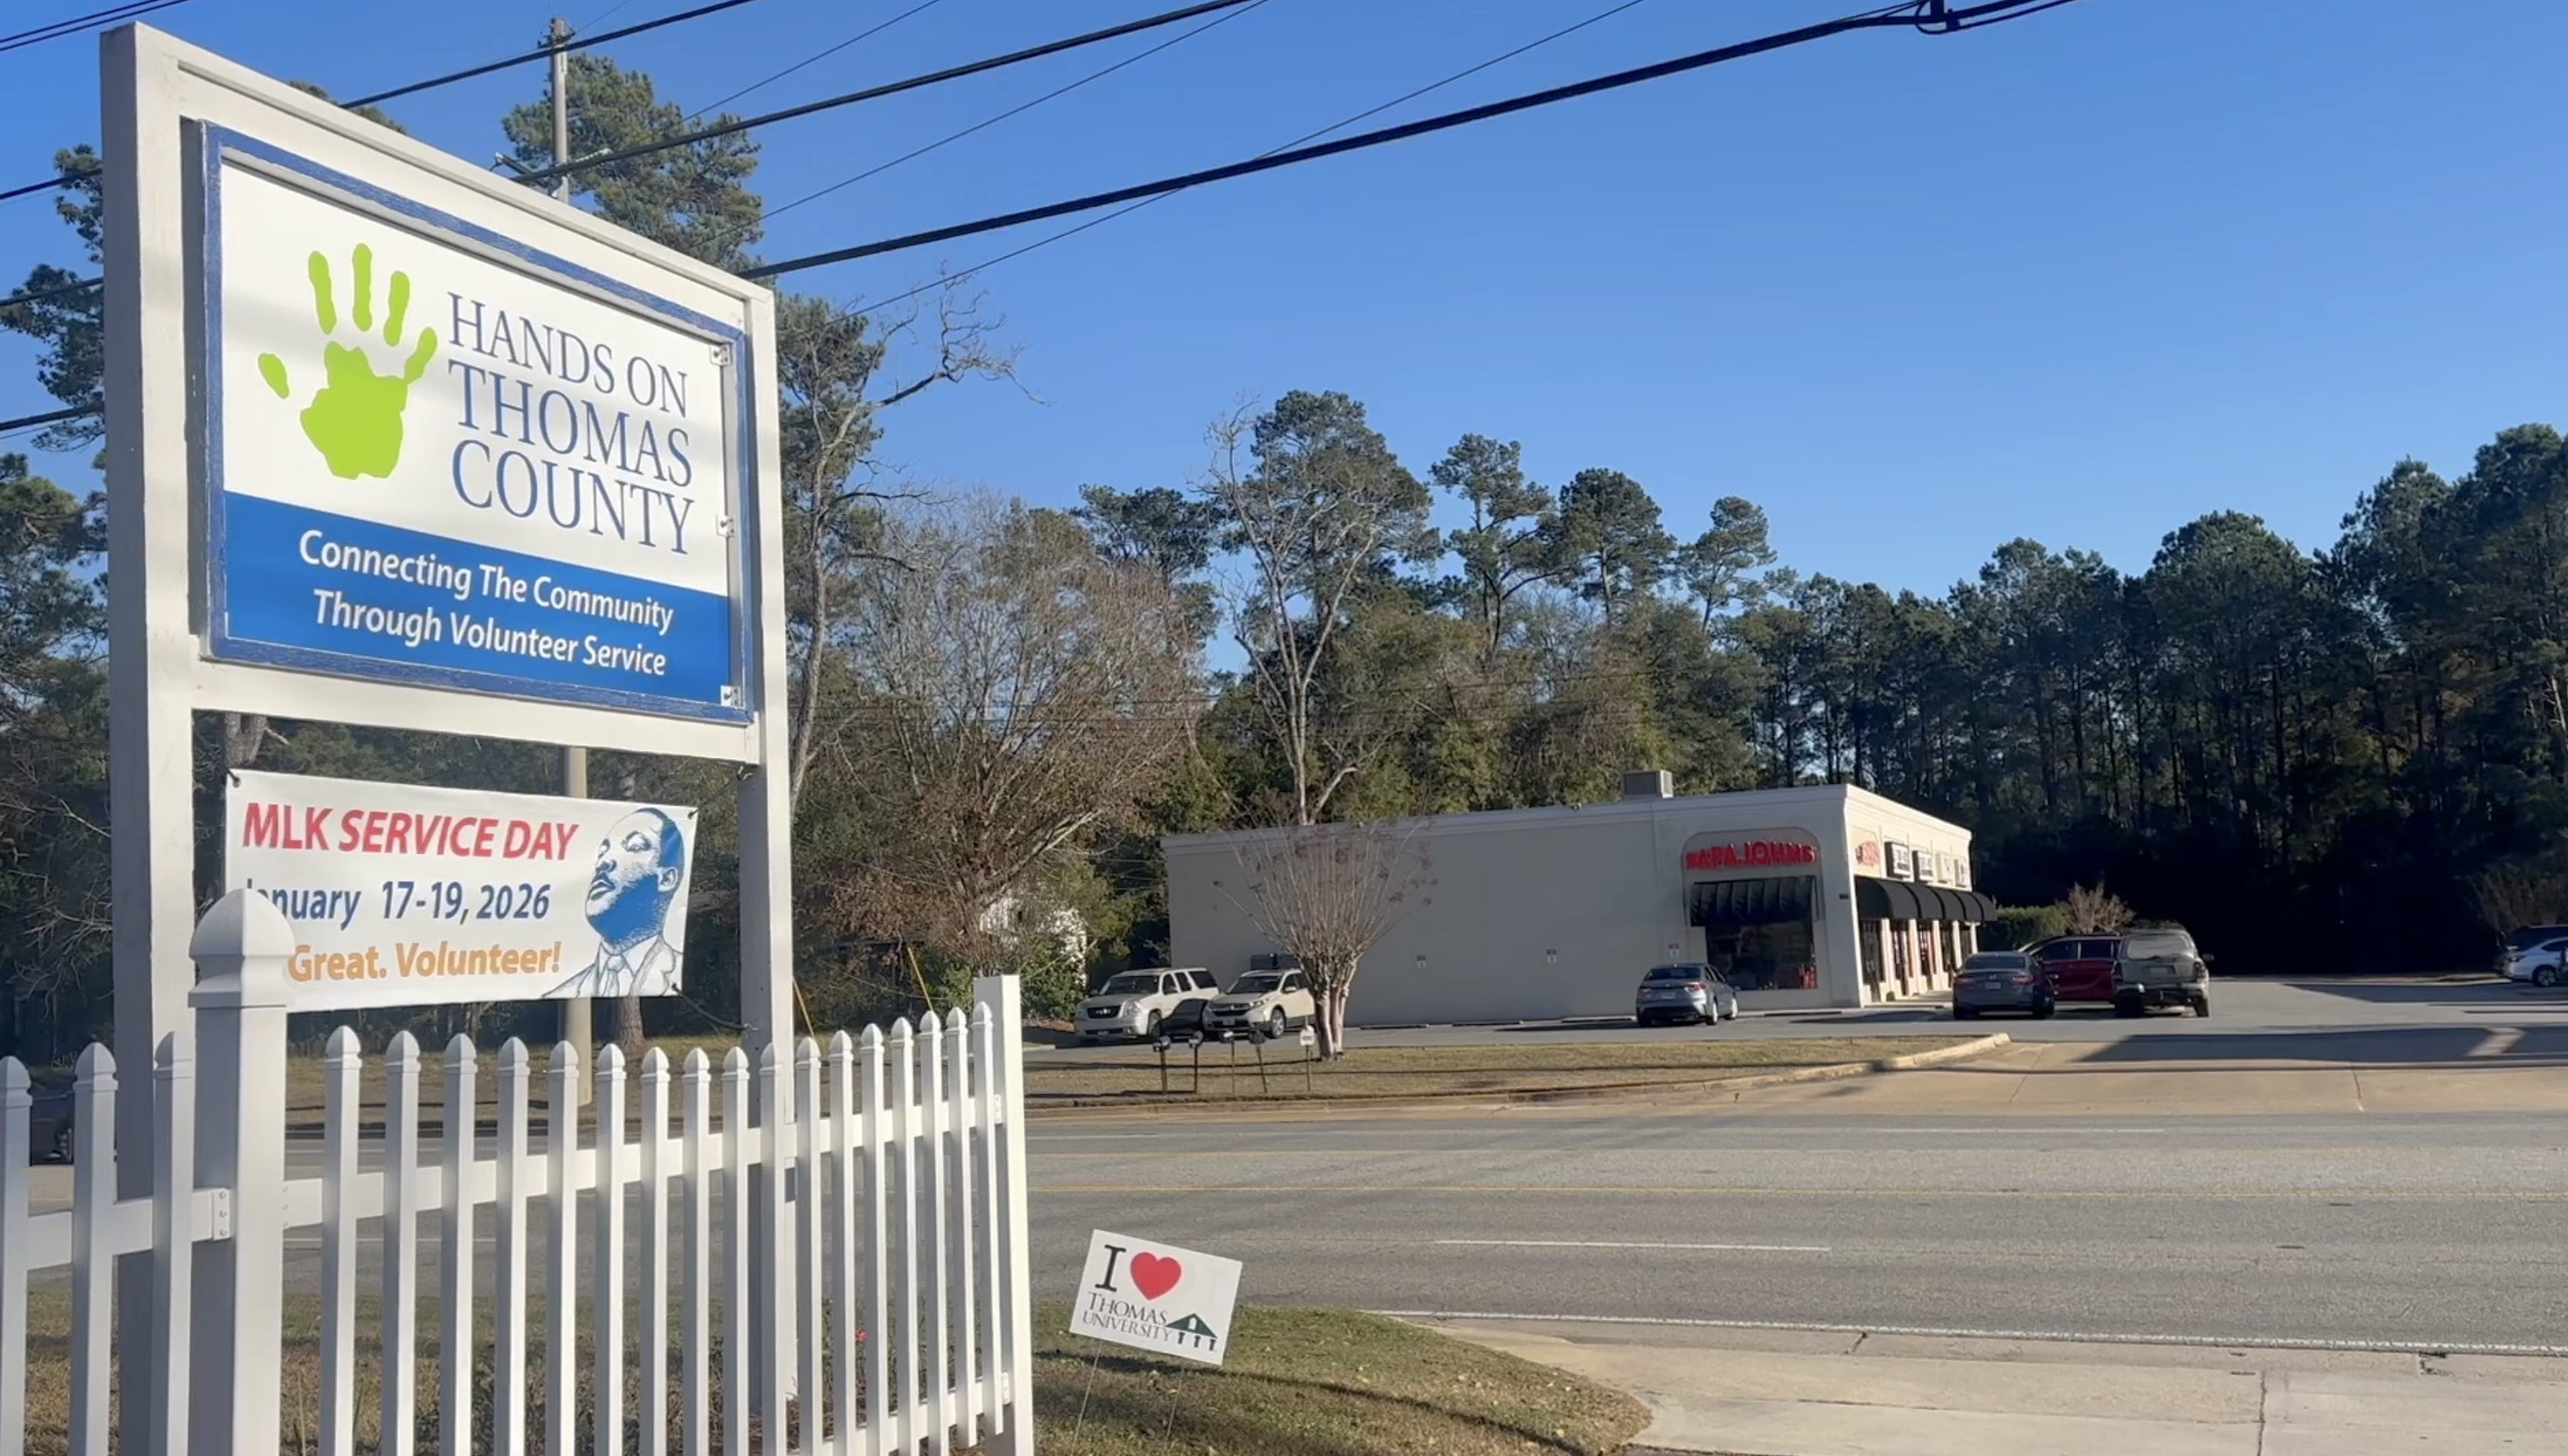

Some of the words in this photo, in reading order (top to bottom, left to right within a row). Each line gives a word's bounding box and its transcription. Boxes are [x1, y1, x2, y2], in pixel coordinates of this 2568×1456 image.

[448, 292, 615, 394] HANDS
[627, 356, 688, 418] ON
[448, 359, 693, 487] THOMAS
[452, 439, 695, 555] COUNTY
[299, 530, 473, 600] Connecting
[479, 564, 527, 603] The
[533, 576, 674, 636] Community
[313, 589, 442, 647] Through
[450, 614, 579, 663] Volunteer
[583, 634, 667, 676] Service
[243, 803, 332, 851] MLK
[339, 812, 500, 857] SERVICE
[503, 822, 580, 861] DAY
[1686, 843, 1739, 867] PAPA
[289, 944, 387, 983] Great.
[395, 941, 561, 978] Volunteer!
[1095, 1244, 1127, 1292] I
[1083, 1311, 1173, 1342] UNIVERSITY
[1088, 1292, 1168, 1324] THOMAS
